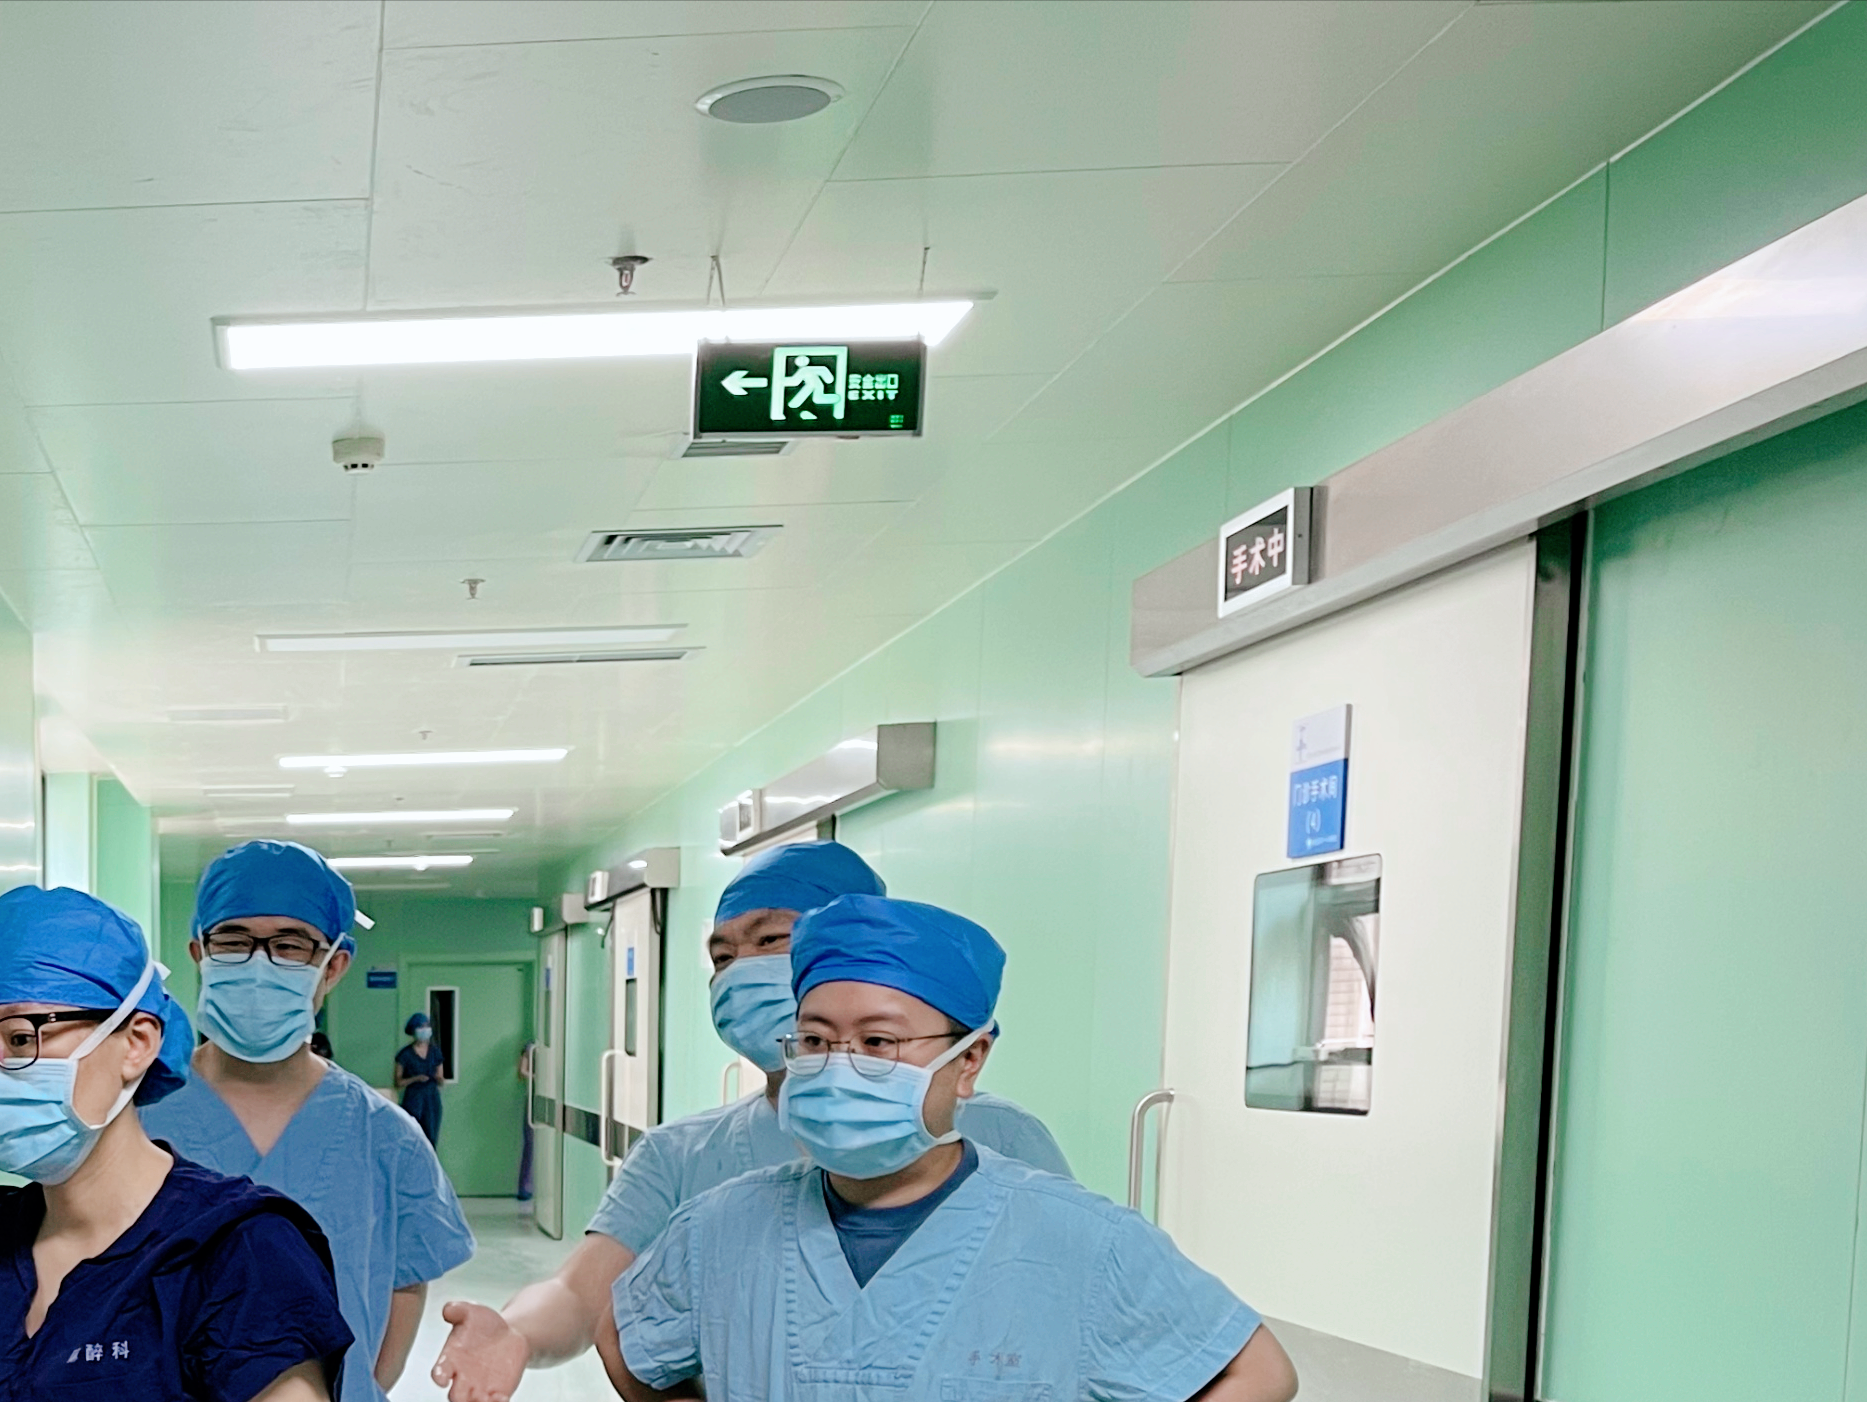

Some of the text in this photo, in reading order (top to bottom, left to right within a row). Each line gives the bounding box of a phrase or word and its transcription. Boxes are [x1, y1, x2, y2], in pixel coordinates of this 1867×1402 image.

[847, 390, 899, 401] EXIT
[1231, 527, 1285, 585] 手术中
